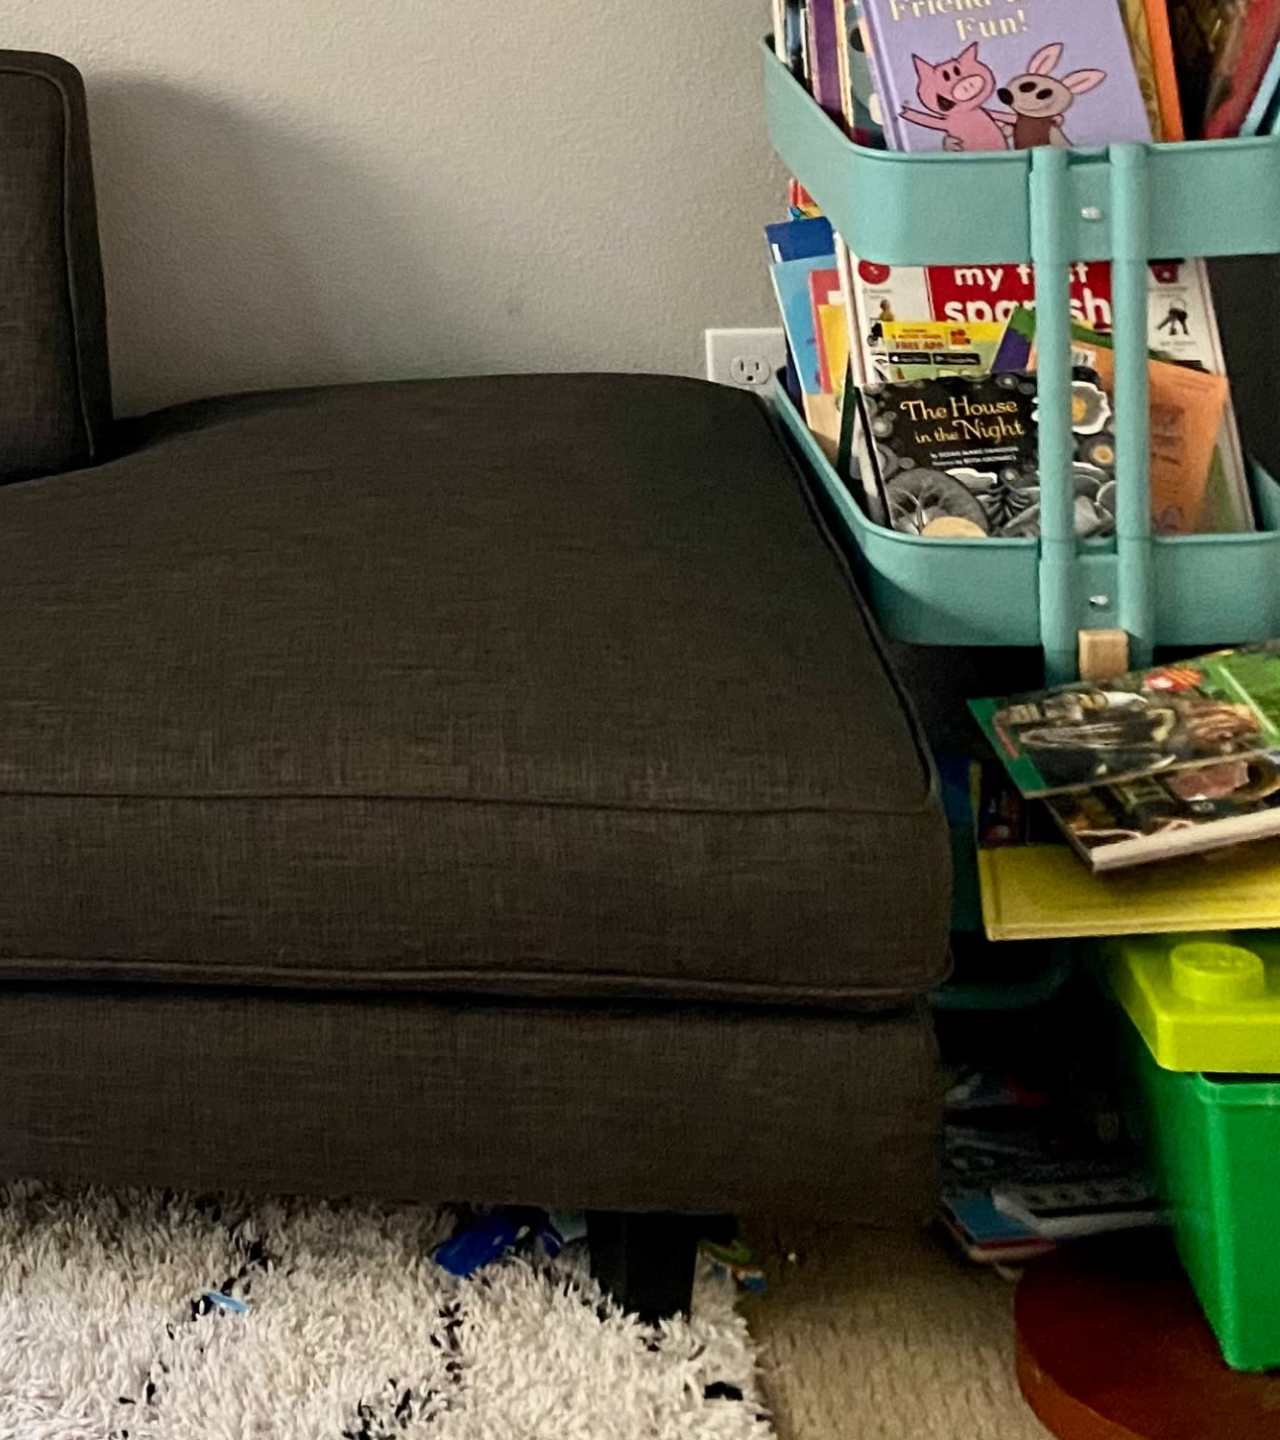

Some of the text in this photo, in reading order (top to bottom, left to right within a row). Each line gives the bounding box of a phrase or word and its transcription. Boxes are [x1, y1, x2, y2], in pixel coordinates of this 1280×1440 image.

[954, 9, 1029, 42] Fun!
[953, 267, 1004, 292] my
[899, 395, 1019, 421] The House
[913, 416, 1026, 445] in the Night
